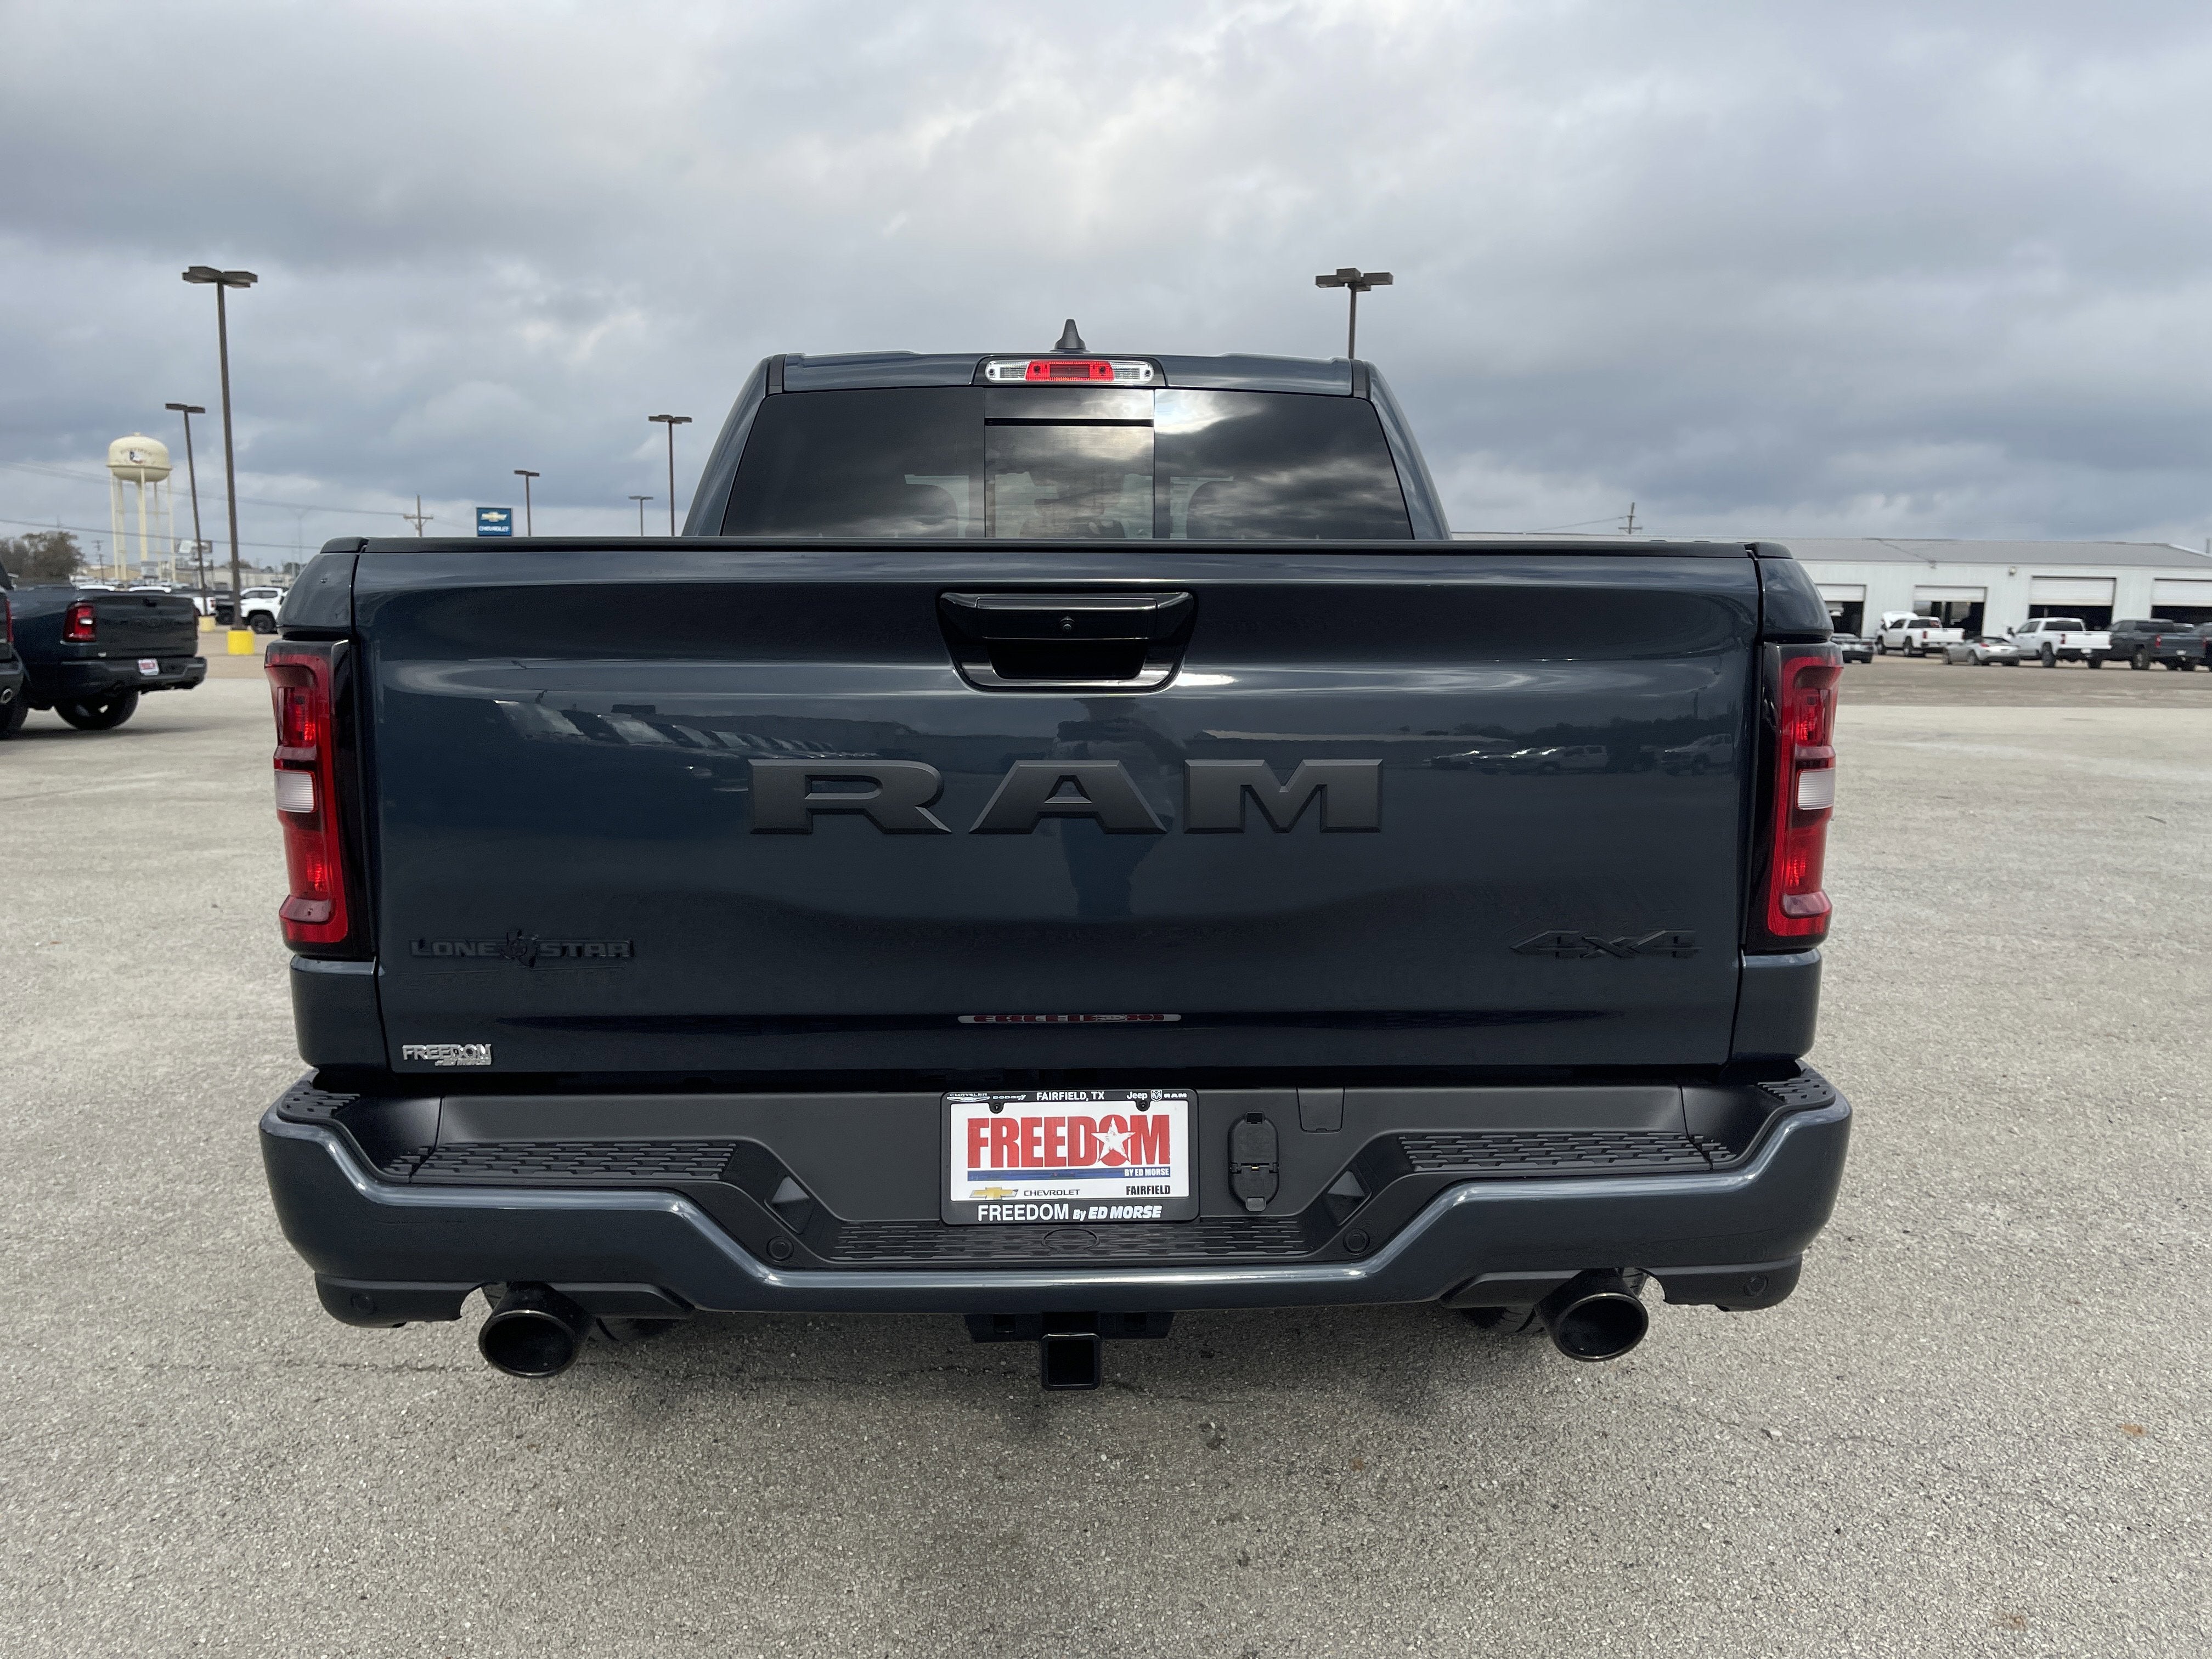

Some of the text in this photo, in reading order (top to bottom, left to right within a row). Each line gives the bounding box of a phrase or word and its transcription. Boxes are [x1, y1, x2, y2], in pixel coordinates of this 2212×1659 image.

[748, 759, 1383, 834] RAM
[410, 939, 633, 957] LONE STAR
[402, 1044, 492, 1060] FREEDOM
[1036, 1091, 1104, 1101] FAIRFIELD, TX
[1126, 1091, 1148, 1100] Jeep
[967, 1114, 1171, 1168] FREEDOM
[1144, 1168, 1169, 1176] MORSE
[1126, 1185, 1171, 1195] FAIRFIELD
[978, 1204, 1162, 1221] FREEDOM By ED MORSE
